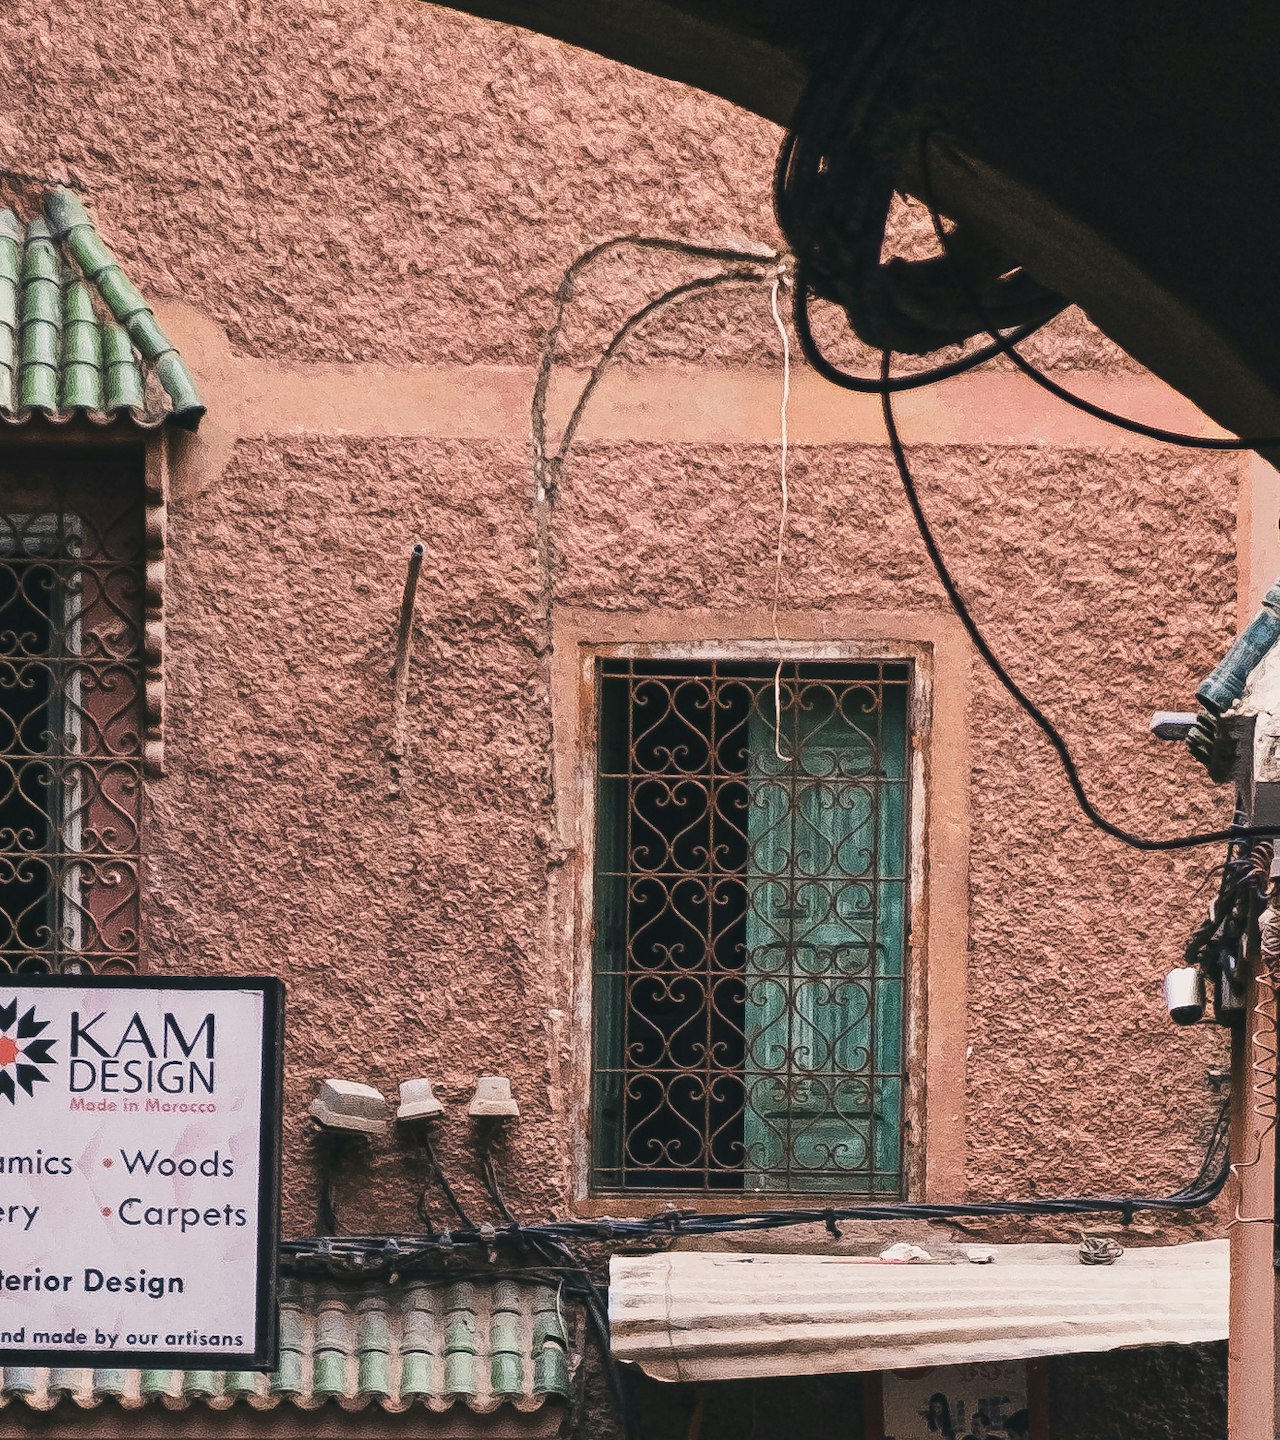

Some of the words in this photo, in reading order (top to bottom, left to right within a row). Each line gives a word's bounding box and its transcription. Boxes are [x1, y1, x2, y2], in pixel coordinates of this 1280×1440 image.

[69, 1011, 217, 1059] KAM
[69, 1060, 216, 1094] DESIGN
[69, 1097, 118, 1112] Made
[123, 1098, 140, 1112] in
[145, 1098, 217, 1114] Morocco
[120, 1148, 235, 1178] Woods
[118, 1197, 248, 1233] Carpets
[83, 1268, 185, 1298] Design
[33, 1329, 88, 1345] made
[95, 1329, 120, 1348] by
[126, 1333, 158, 1346] our
[165, 1330, 244, 1348] artisans
